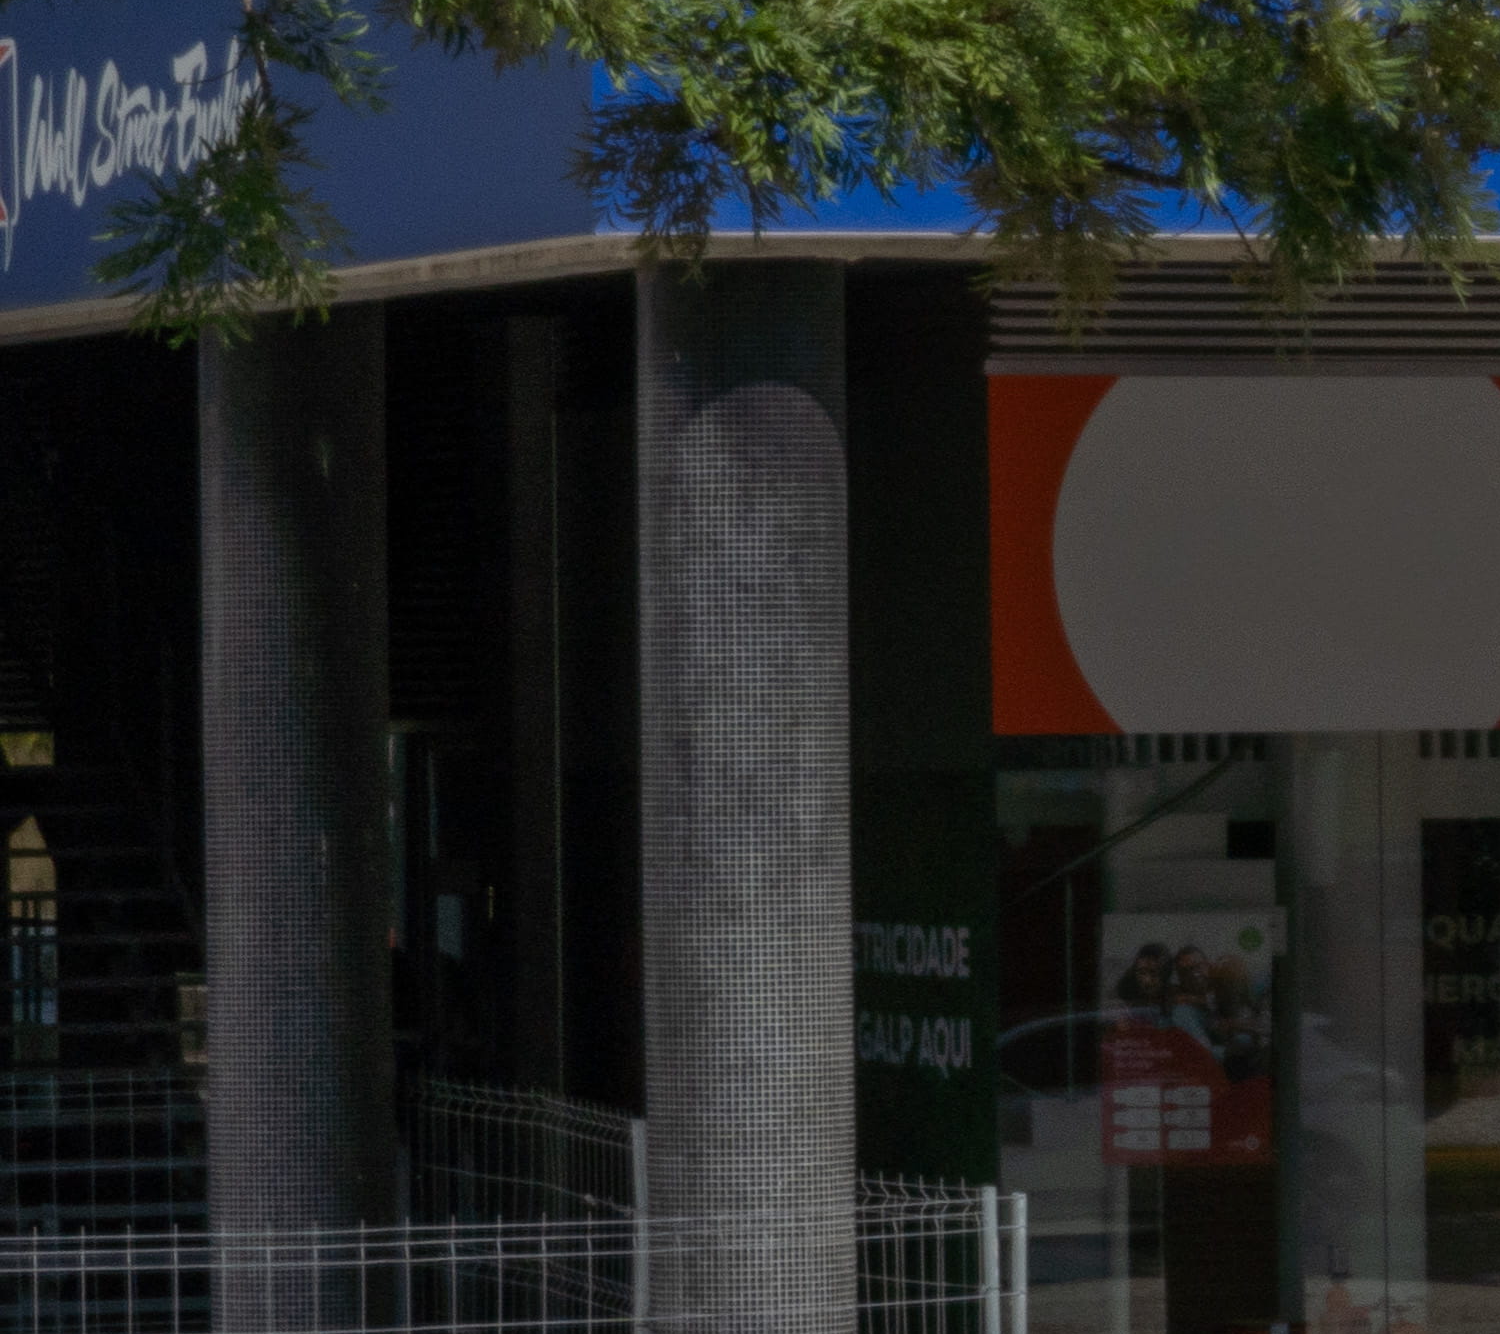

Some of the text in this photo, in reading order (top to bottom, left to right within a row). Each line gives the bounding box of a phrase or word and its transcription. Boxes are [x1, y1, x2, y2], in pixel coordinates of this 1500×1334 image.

[24, 67, 92, 208] Wall
[90, 59, 175, 188] Street
[856, 921, 971, 978] TRICIDADE
[917, 1016, 973, 1080] AQUI
